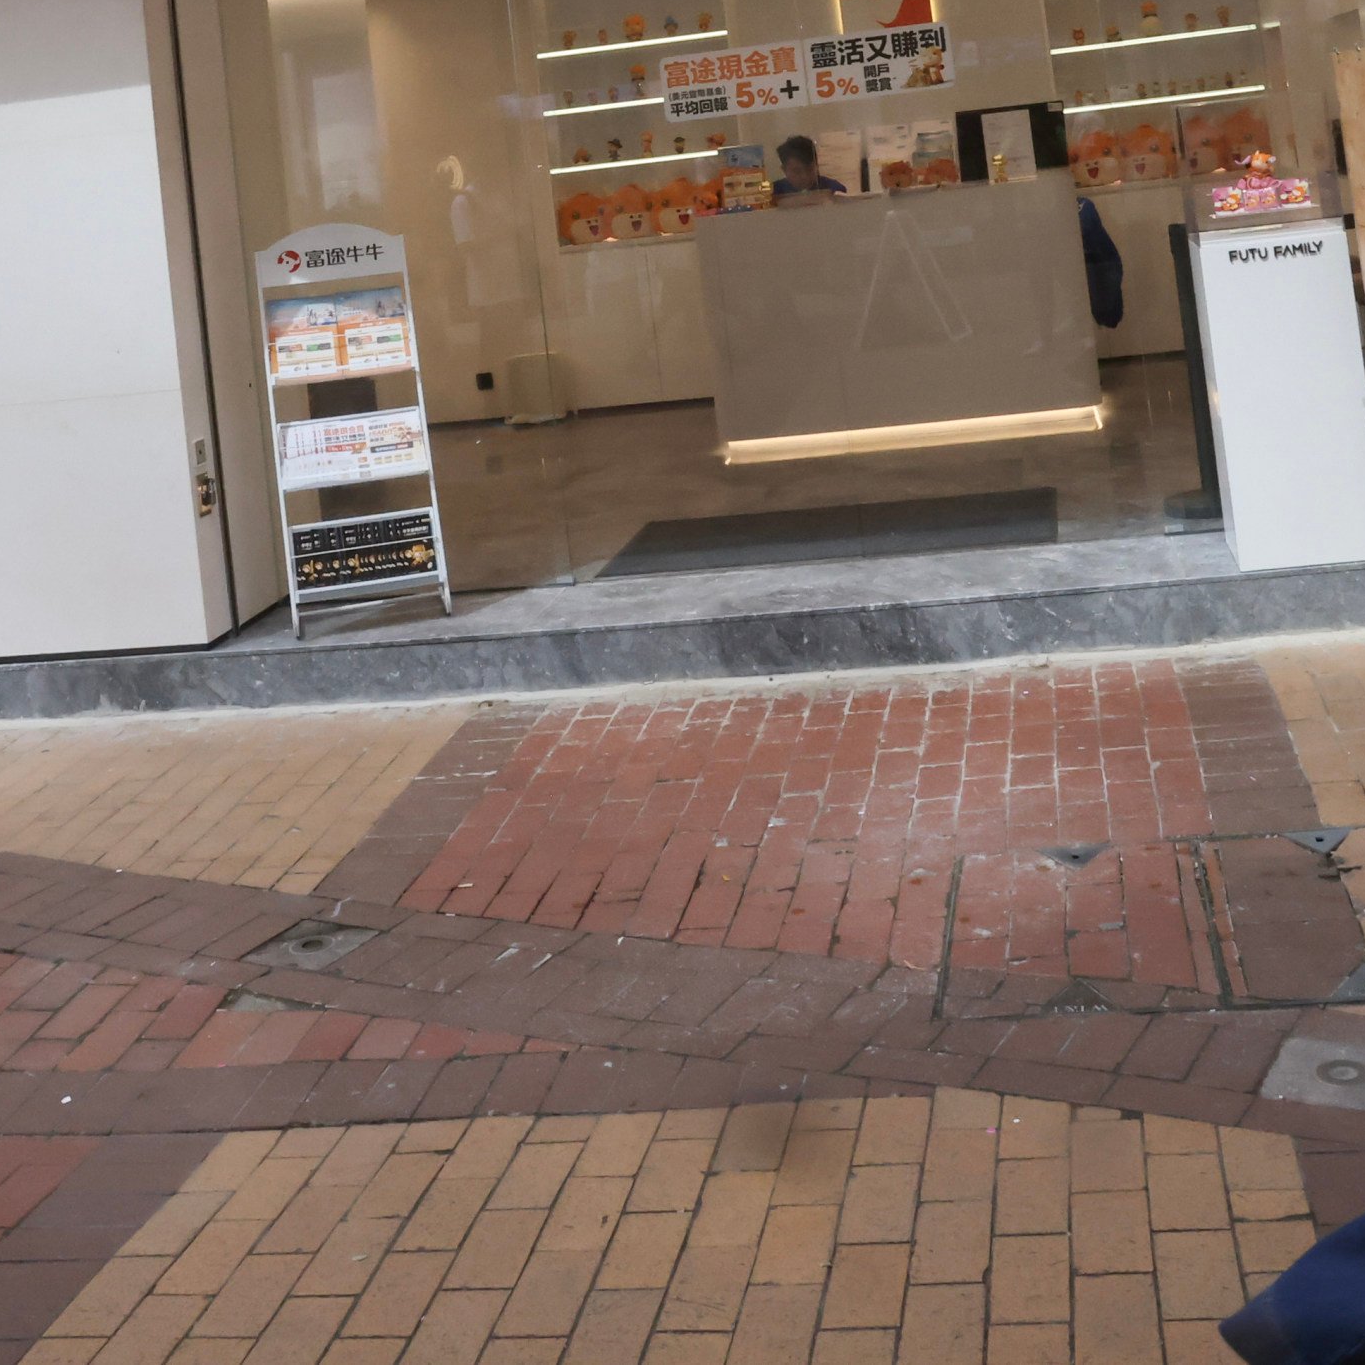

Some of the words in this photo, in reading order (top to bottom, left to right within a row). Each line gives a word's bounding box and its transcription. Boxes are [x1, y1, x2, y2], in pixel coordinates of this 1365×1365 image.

[809, 26, 947, 70] 靈活又賺到
[664, 45, 798, 88] 富途現金寶
[815, 71, 861, 99] 5%
[670, 96, 730, 118] 平均回報
[304, 242, 385, 269] 富途牛牛
[1228, 247, 1268, 264] FUTU
[1273, 240, 1324, 259] FAMILY
